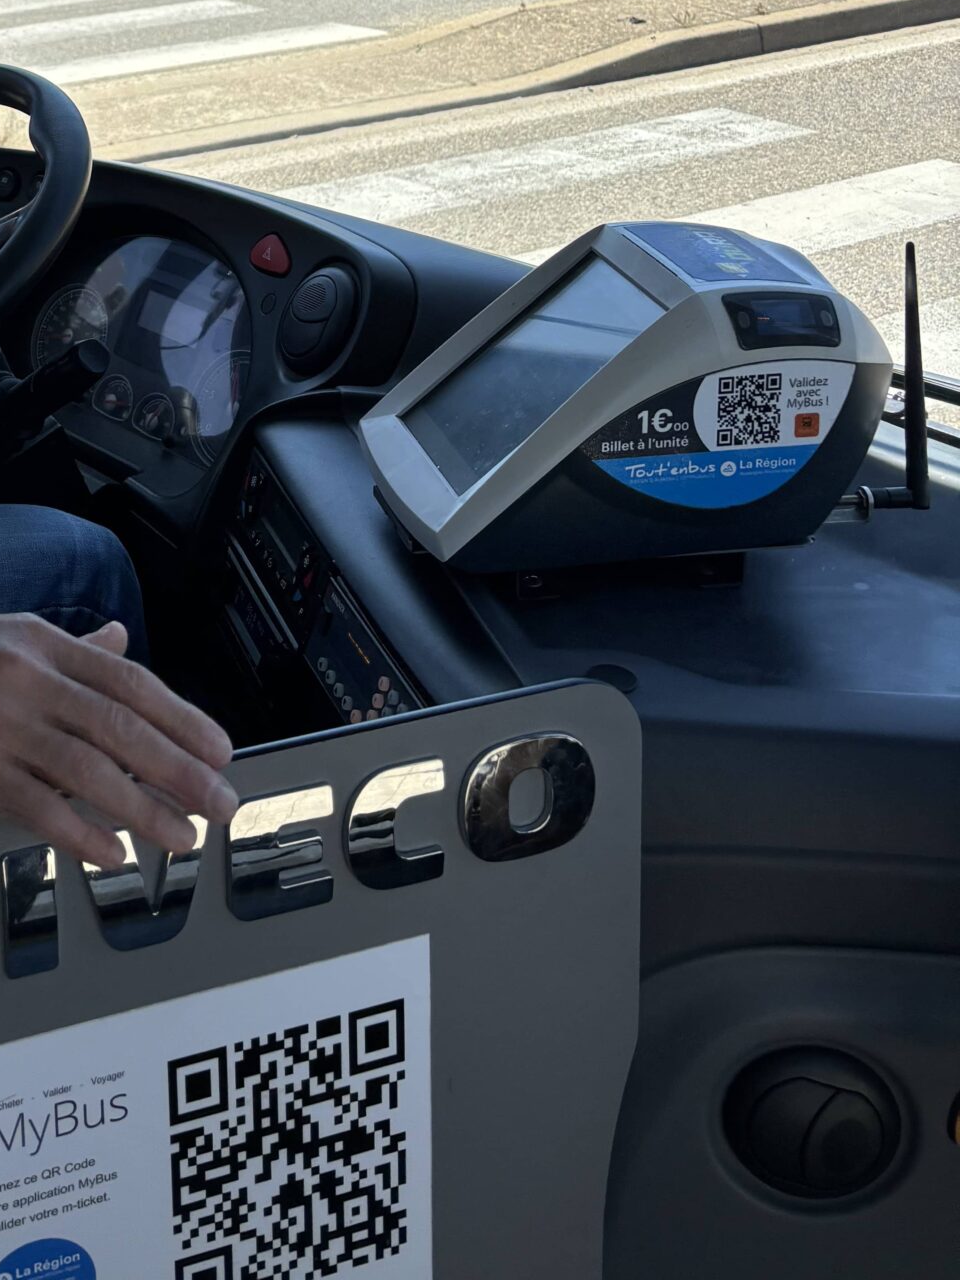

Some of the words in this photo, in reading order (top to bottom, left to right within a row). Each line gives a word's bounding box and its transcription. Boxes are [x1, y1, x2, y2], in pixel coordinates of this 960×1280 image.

[789, 376, 829, 389] Validez
[795, 387, 822, 398] avec
[787, 396, 824, 410] MyBus
[601, 440, 635, 453] Billet
[637, 439, 646, 450] à
[648, 435, 690, 450] l'unité
[625, 461, 717, 478] Tout'enbus
[740, 459, 754, 470] La
[755, 456, 797, 472] Région
[0, 730, 596, 980] IVECO
[42, 1083, 73, 1099] Valider
[90, 1070, 126, 1087] Voyager
[24, 1174, 38, 1186] ce
[41, 1166, 62, 1181] QR
[64, 1157, 96, 1174] Code
[12, 1183, 76, 1211] application
[78, 1170, 119, 1191] MyBus
[30, 1207, 59, 1223] votre
[61, 1192, 111, 1214] m-ticket.
[15, 1265, 32, 1279] La
[34, 1252, 81, 1274] Région
